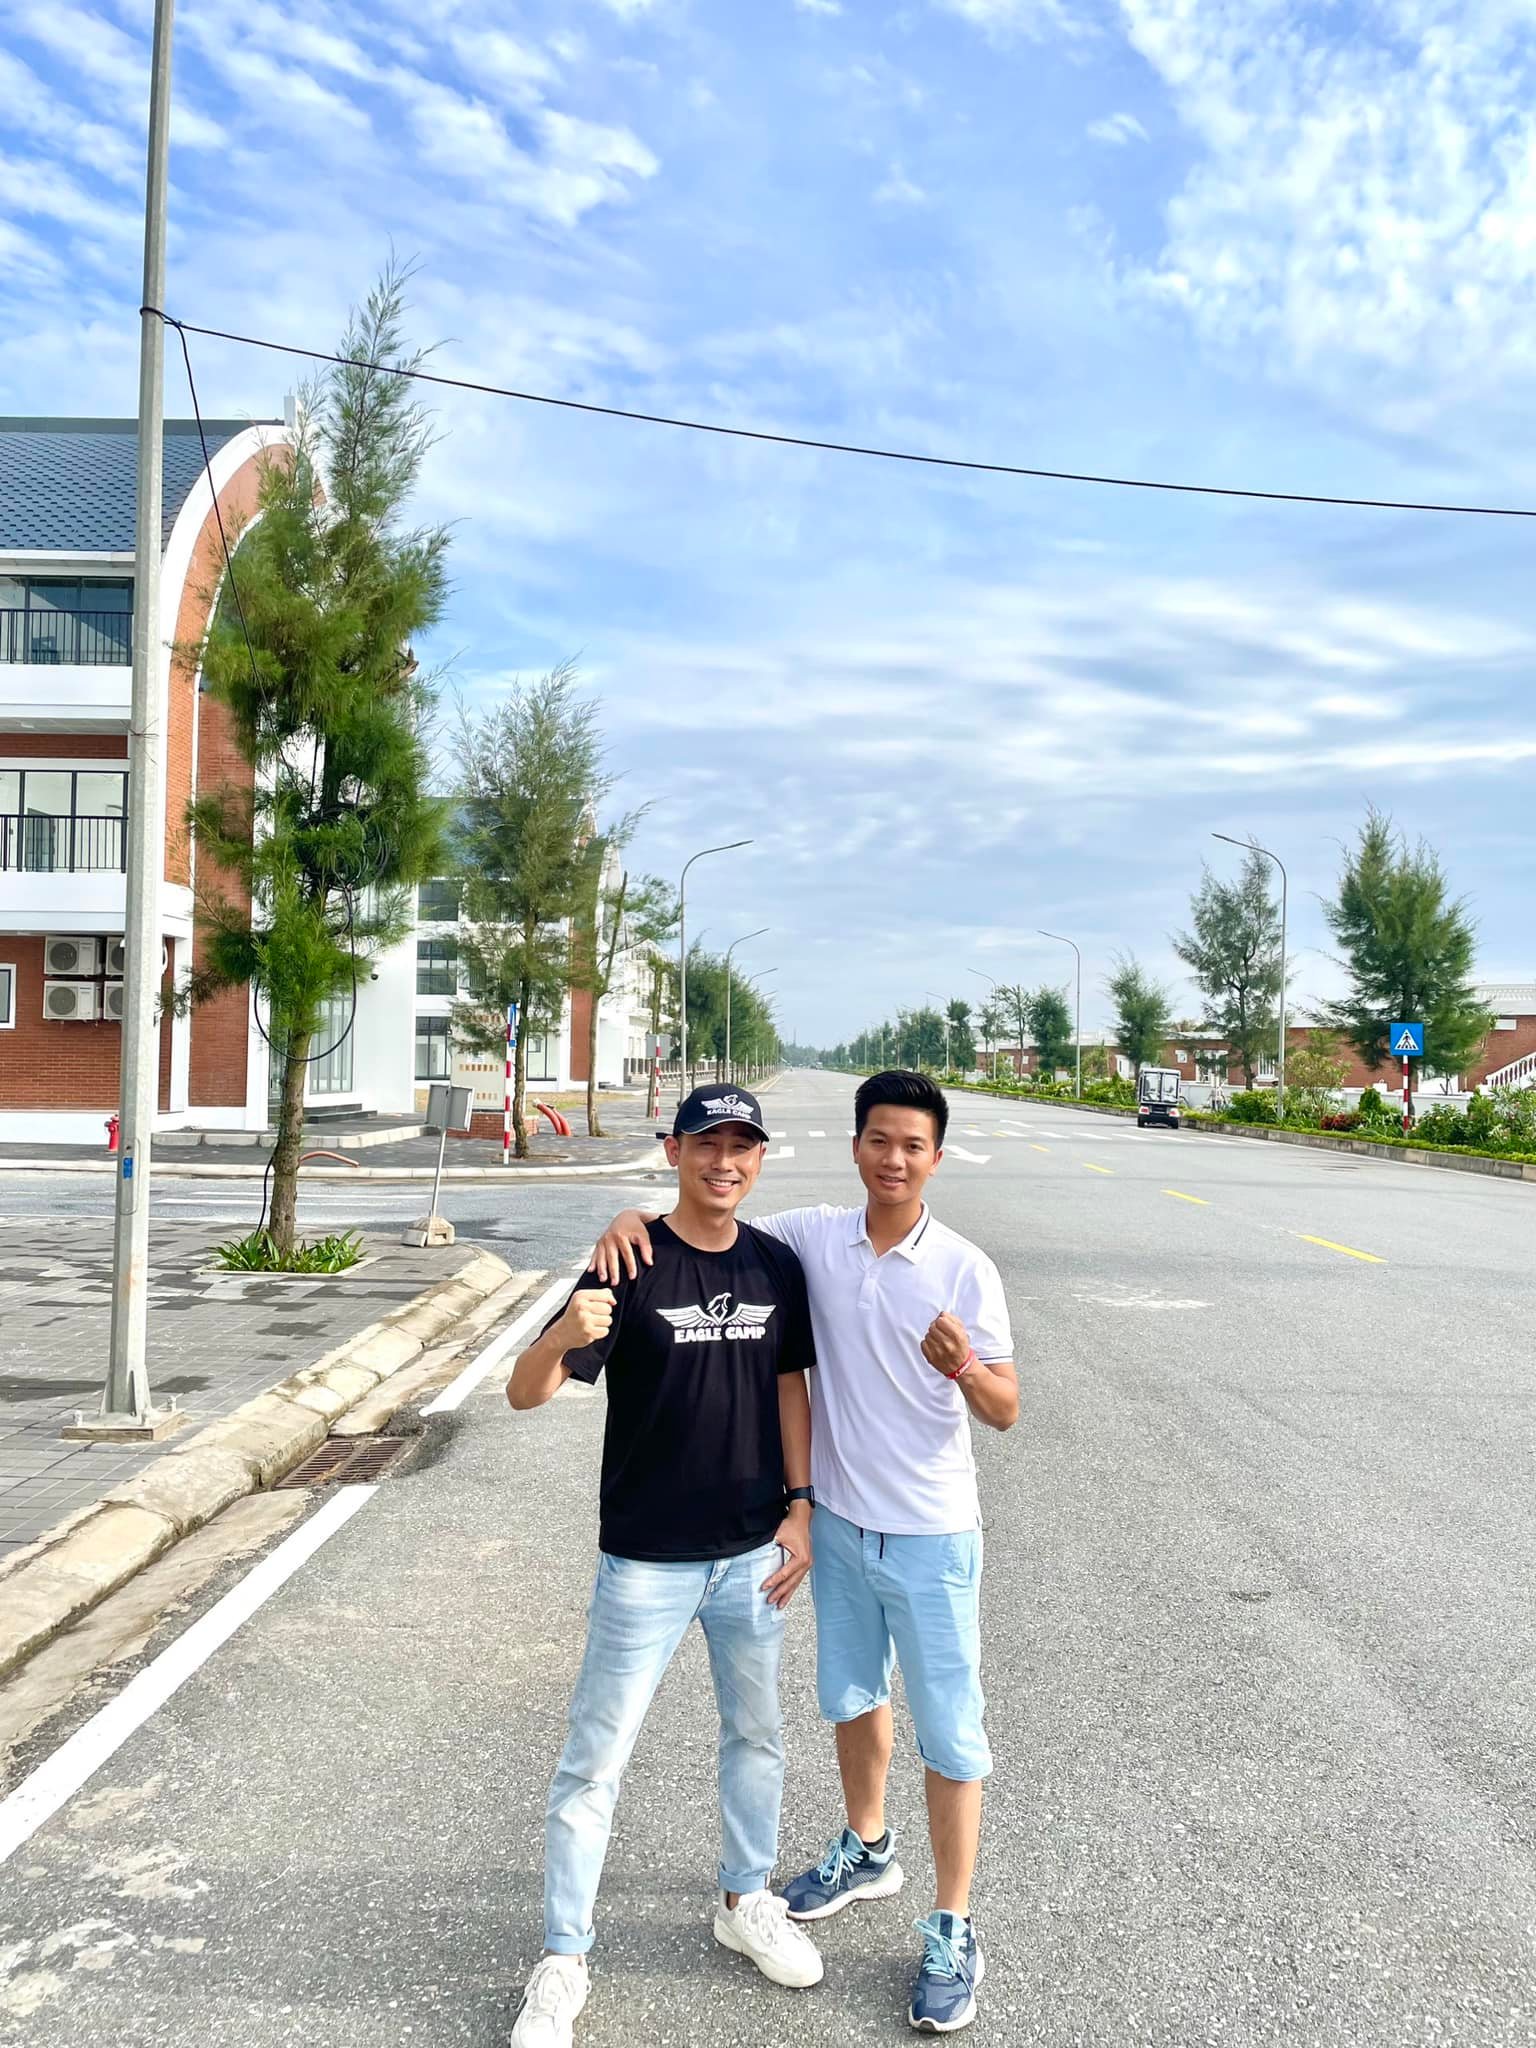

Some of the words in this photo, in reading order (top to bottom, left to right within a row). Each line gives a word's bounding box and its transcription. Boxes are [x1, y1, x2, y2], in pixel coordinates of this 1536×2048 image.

[732, 1110, 751, 1120] CAMP
[674, 1327, 722, 1343] EAGLE
[725, 1326, 766, 1340] CAMP
